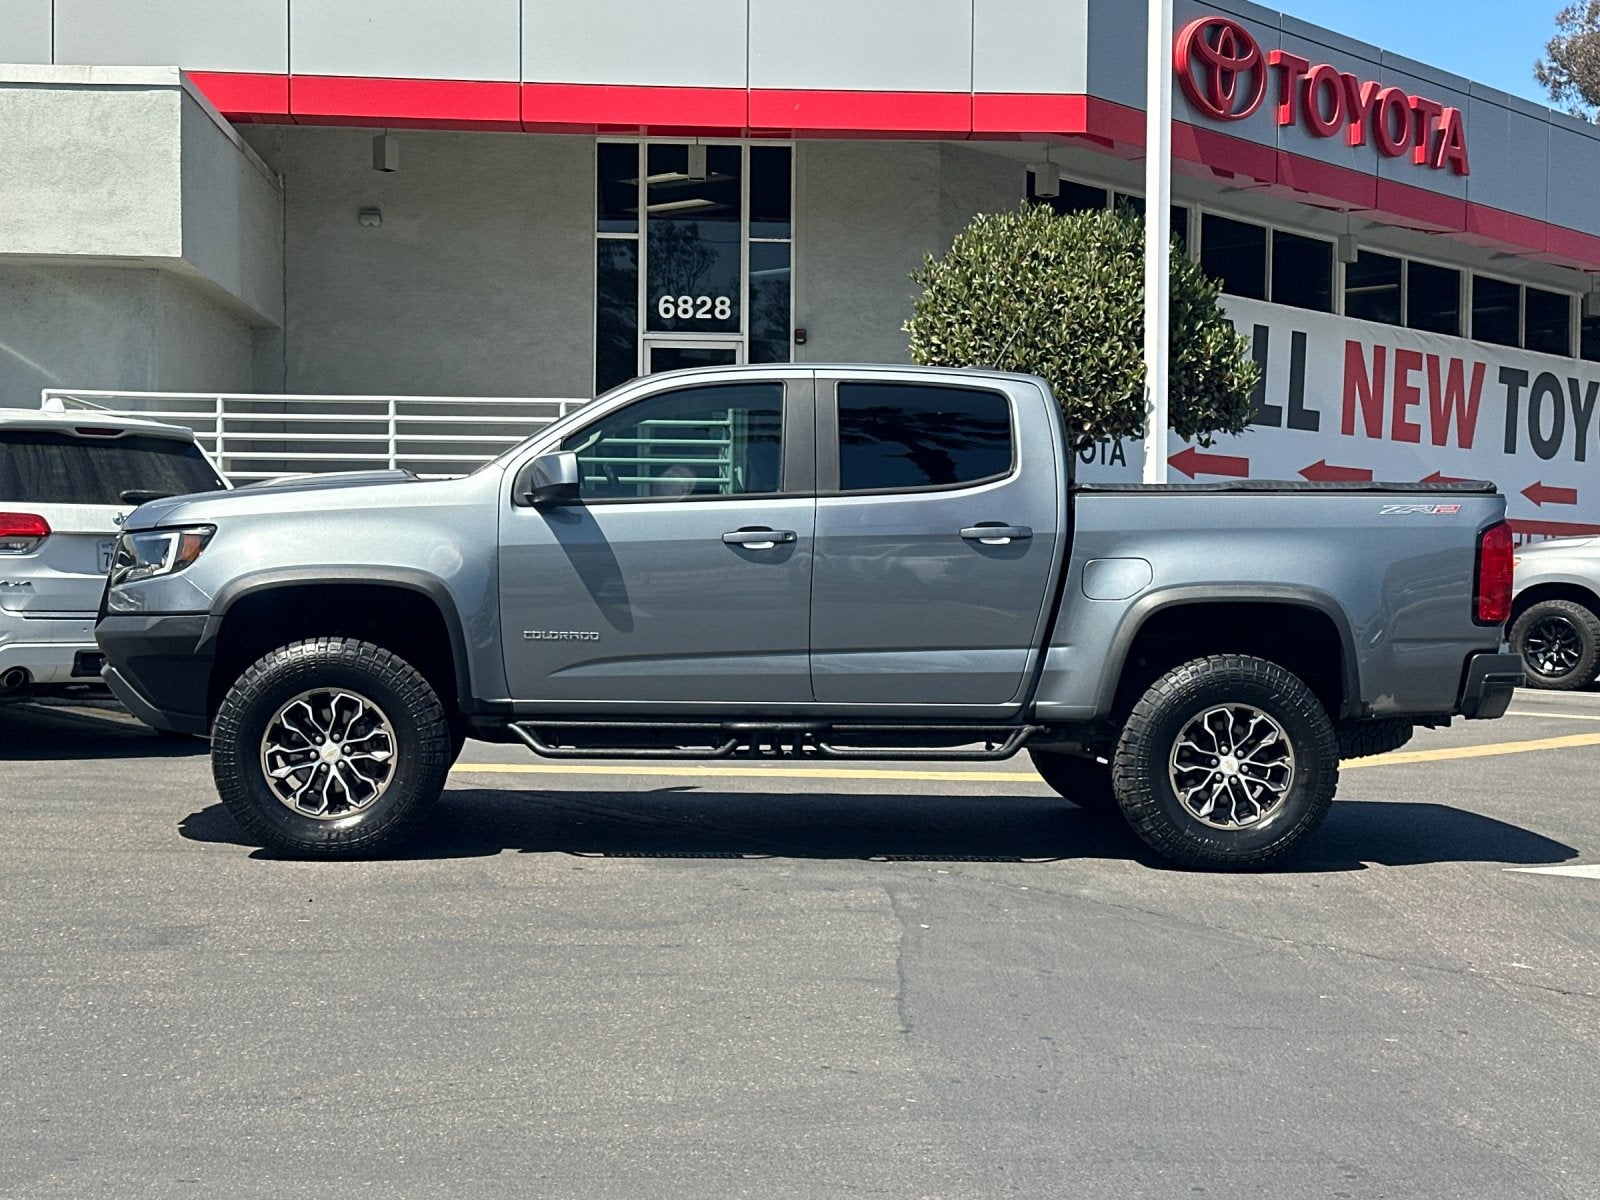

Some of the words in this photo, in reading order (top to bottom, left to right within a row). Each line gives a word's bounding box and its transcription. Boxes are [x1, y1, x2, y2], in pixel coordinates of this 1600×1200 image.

[1269, 49, 1470, 176] TOYOTA
[658, 295, 731, 320] 6828
[1222, 318, 1320, 432] LL
[1341, 339, 1487, 450] NEW
[1499, 365, 1600, 462] TOY
[1078, 437, 1127, 467] OTA
[1379, 504, 1462, 515] ZR2
[523, 630, 600, 640] COLORADO
